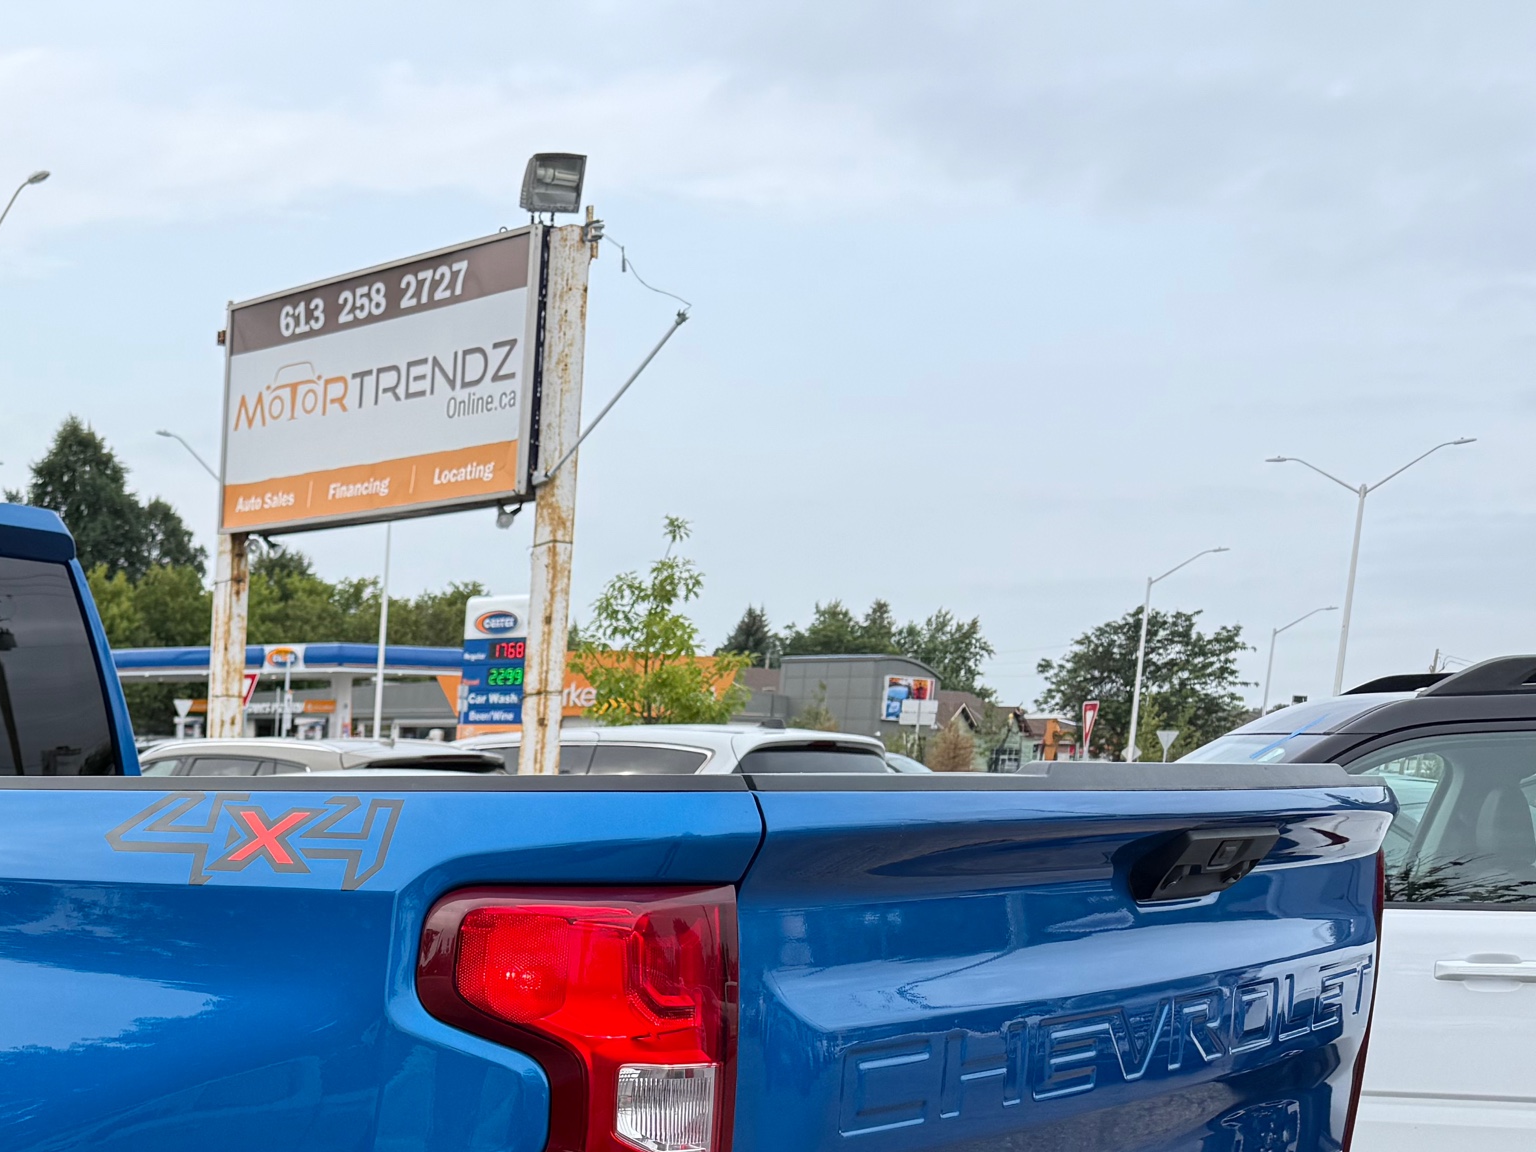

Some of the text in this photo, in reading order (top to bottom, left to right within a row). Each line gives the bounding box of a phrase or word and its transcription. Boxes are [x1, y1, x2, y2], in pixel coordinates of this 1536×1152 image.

[279, 260, 468, 337] 613 258 2727
[446, 389, 517, 419] Online.ca
[433, 461, 494, 485] Locating
[328, 477, 390, 500] Financing
[235, 491, 295, 513] Auto Sales
[467, 692, 518, 704] Car Wash
[838, 954, 1373, 1138] CHEVROLET
